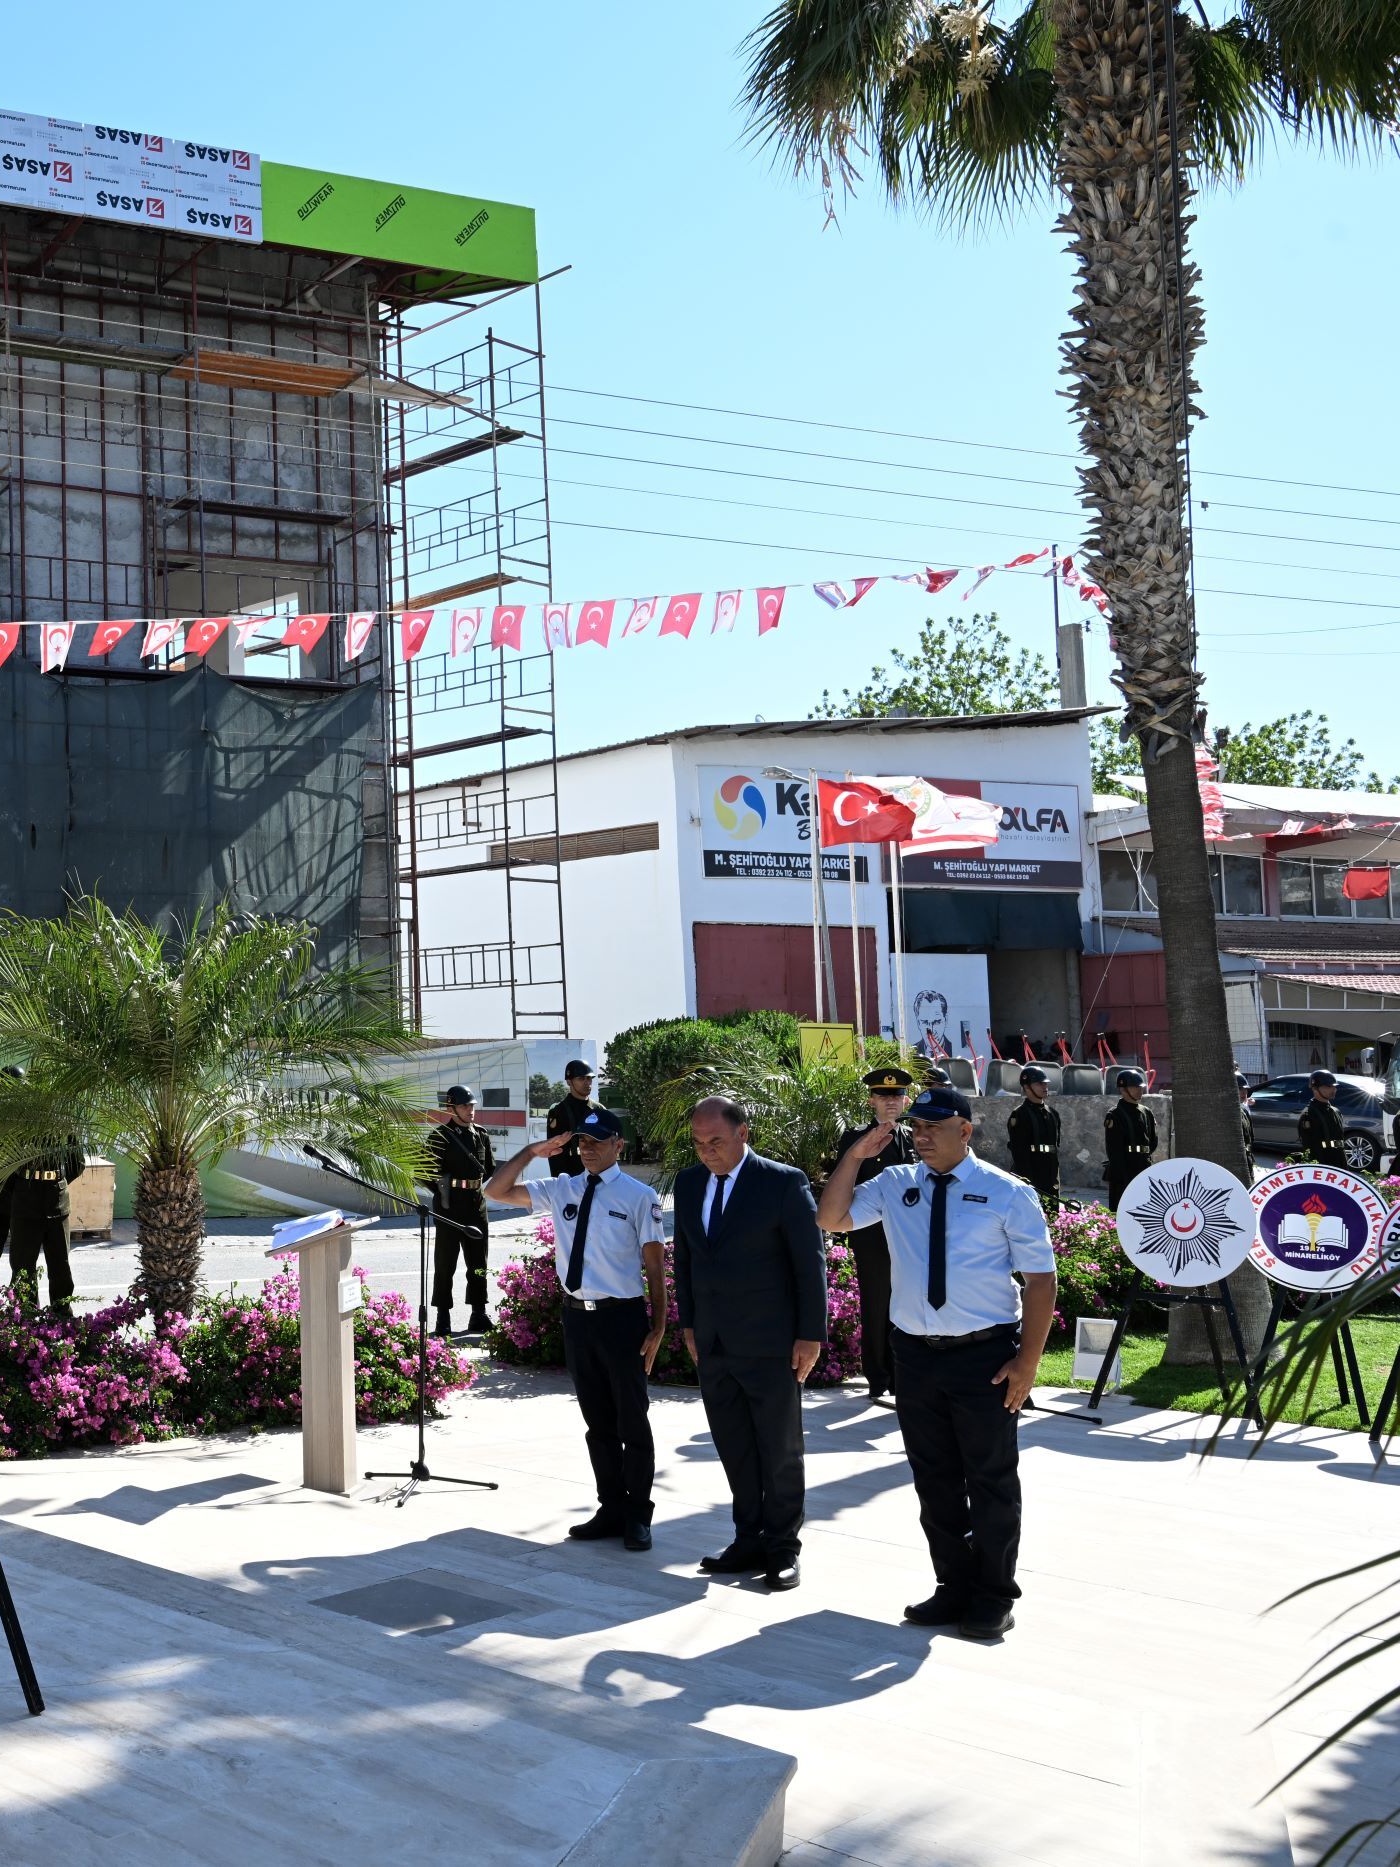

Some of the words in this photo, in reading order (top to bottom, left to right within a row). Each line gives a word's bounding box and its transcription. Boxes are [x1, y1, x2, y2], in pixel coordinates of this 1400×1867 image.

[2, 154, 51, 176] ASAŞ
[96, 190, 144, 212] ASAŞ
[297, 184, 335, 220] OUTWEAR
[375, 196, 406, 228] OUTWEA
[186, 208, 232, 228] ASAŞ
[455, 210, 489, 245] OUTWEAR
[714, 854, 726, 865] M.
[729, 852, 786, 868] ŞEHİTOĞLU
[934, 862, 943, 870] M.
[944, 860, 987, 872] ŞEHİTOĞLU
[989, 863, 1008, 872] YAPI
[1009, 864, 1040, 873] MARKET
[1312, 1170, 1362, 1194] ERAY
[1284, 1251, 1341, 1261] MİNARELİKÖY
